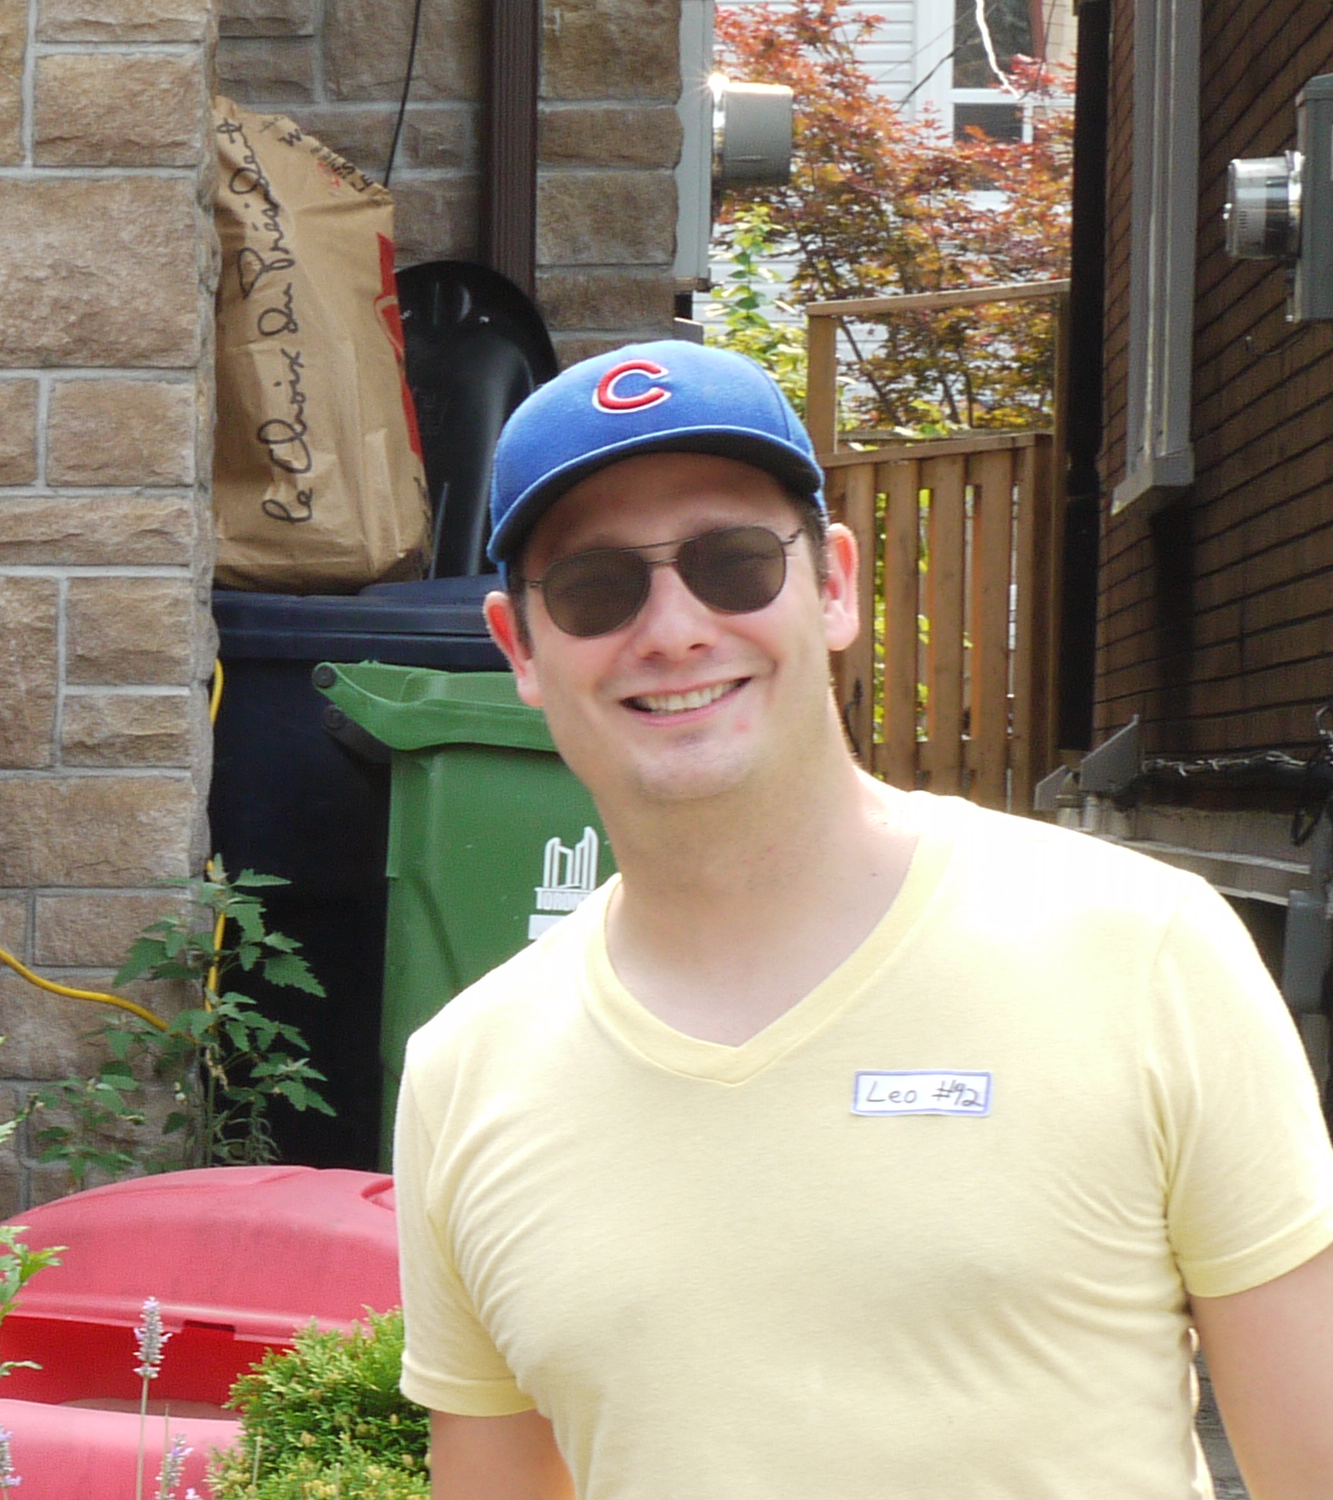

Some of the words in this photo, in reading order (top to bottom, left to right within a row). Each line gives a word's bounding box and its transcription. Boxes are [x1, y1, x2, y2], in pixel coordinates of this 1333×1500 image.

[257, 348, 312, 475] Choix
[592, 359, 672, 414] C
[865, 1080, 917, 1103] Leo
